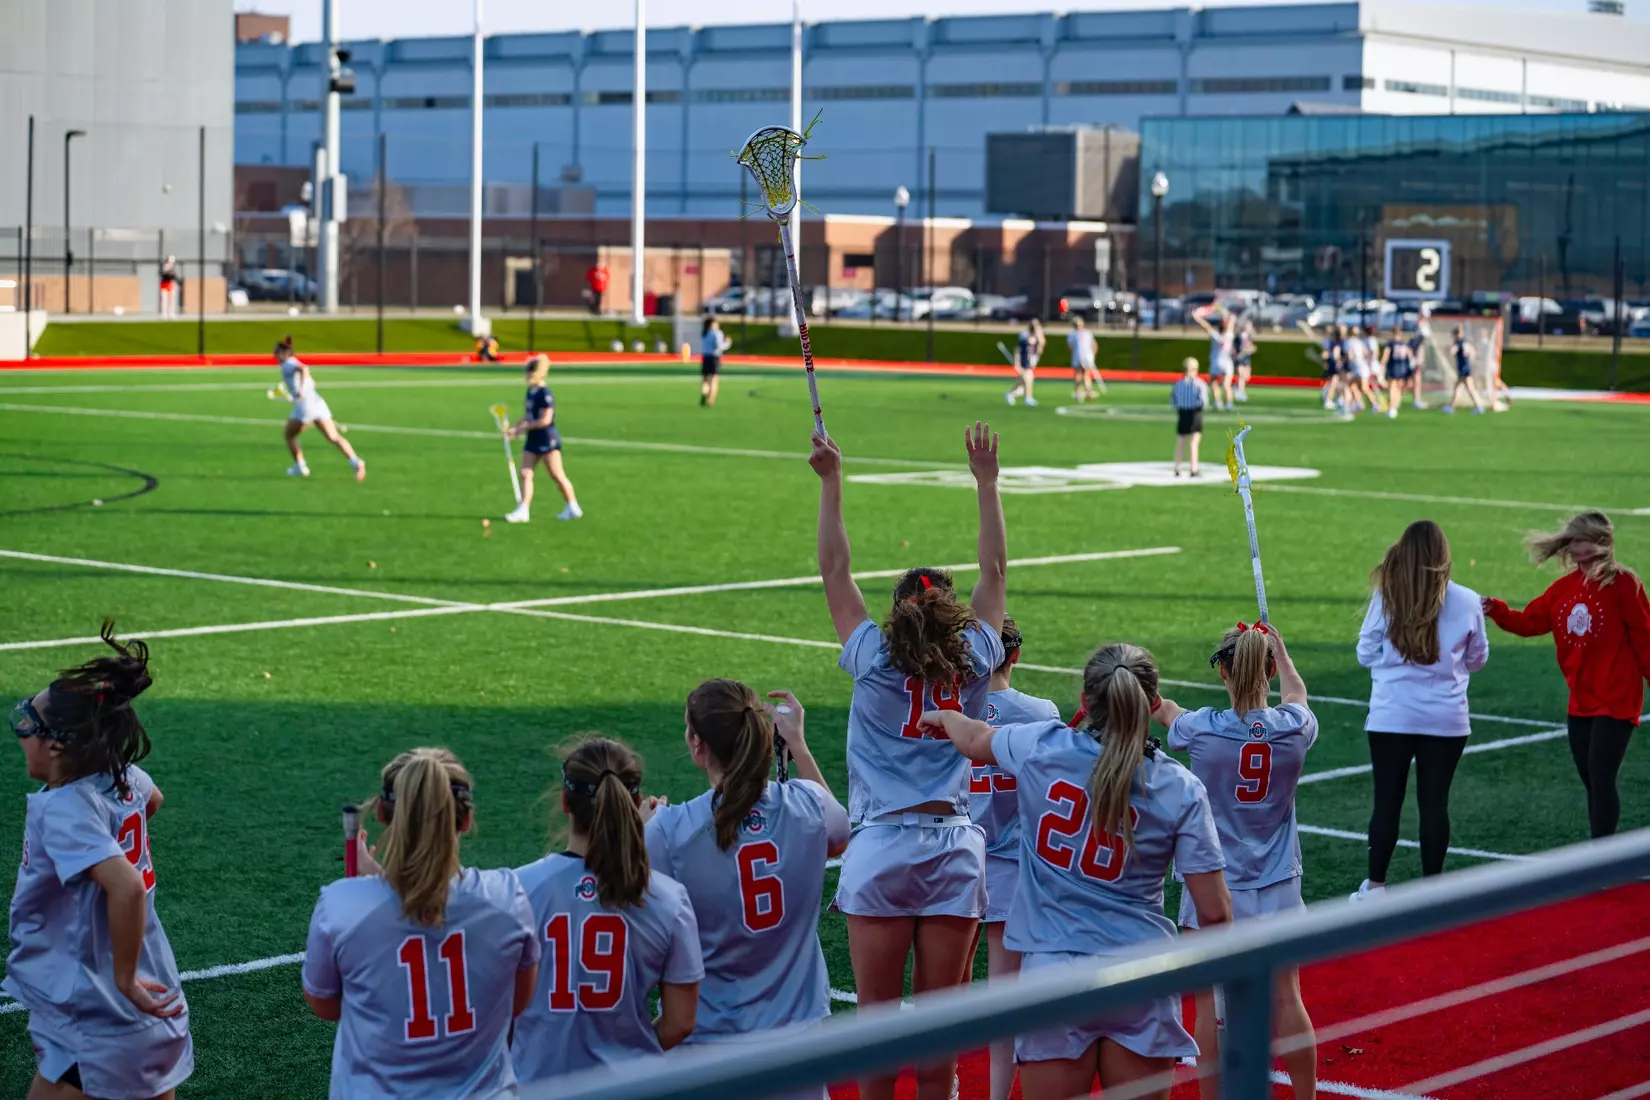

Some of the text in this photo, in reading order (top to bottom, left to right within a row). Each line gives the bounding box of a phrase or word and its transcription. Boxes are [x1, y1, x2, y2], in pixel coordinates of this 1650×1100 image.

[1235, 741, 1273, 803] 9
[1036, 778, 1140, 884] 26
[735, 840, 785, 933] 6
[397, 929, 477, 1042] 11
[544, 912, 629, 1012] 19
